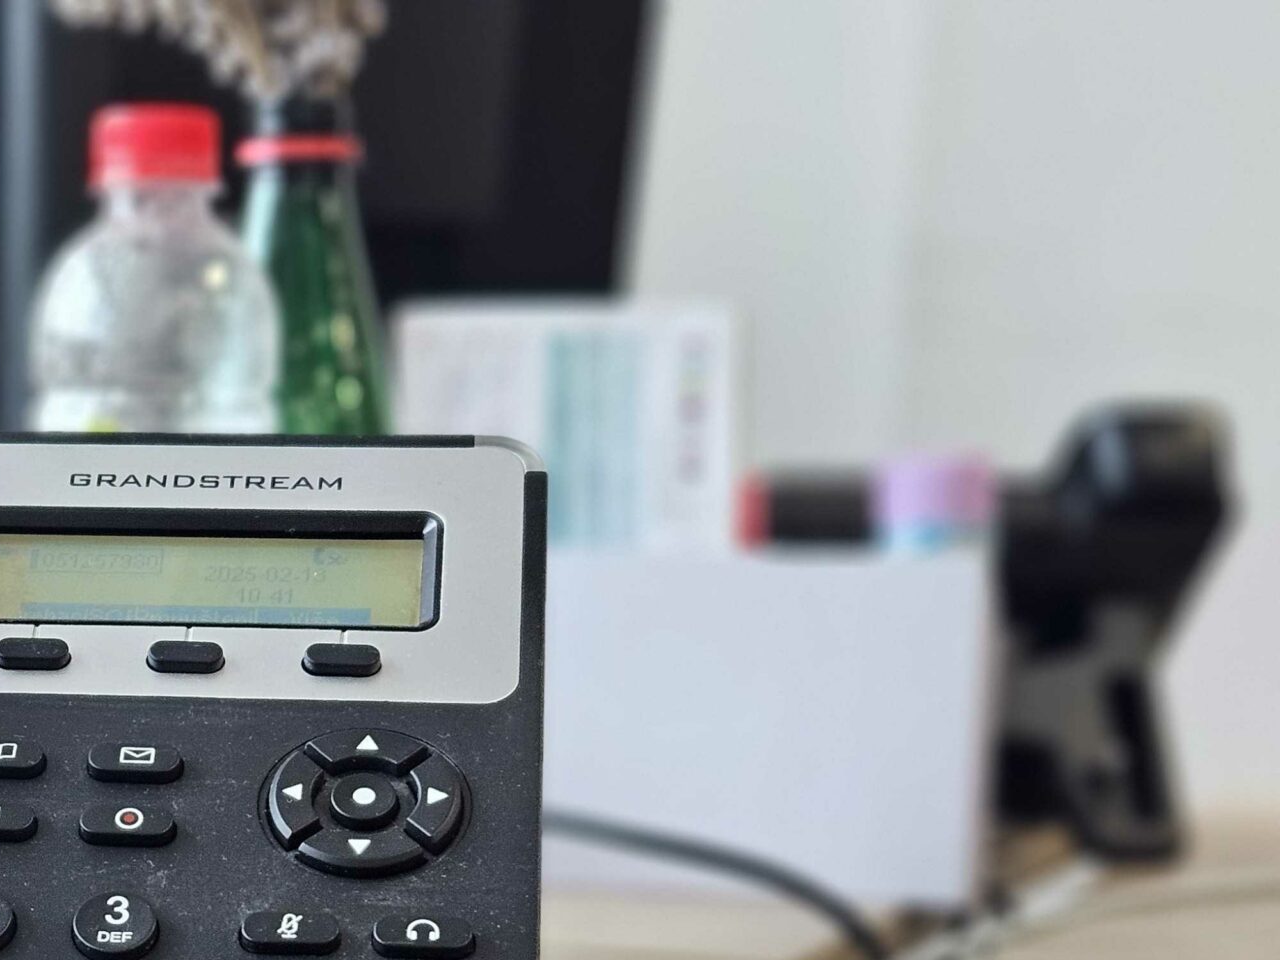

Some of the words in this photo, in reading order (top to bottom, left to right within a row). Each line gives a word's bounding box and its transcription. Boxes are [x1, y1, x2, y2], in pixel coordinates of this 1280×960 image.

[69, 473, 344, 491] GRANDSTREAM
[104, 895, 130, 925] 3
[96, 930, 134, 944] DEF
